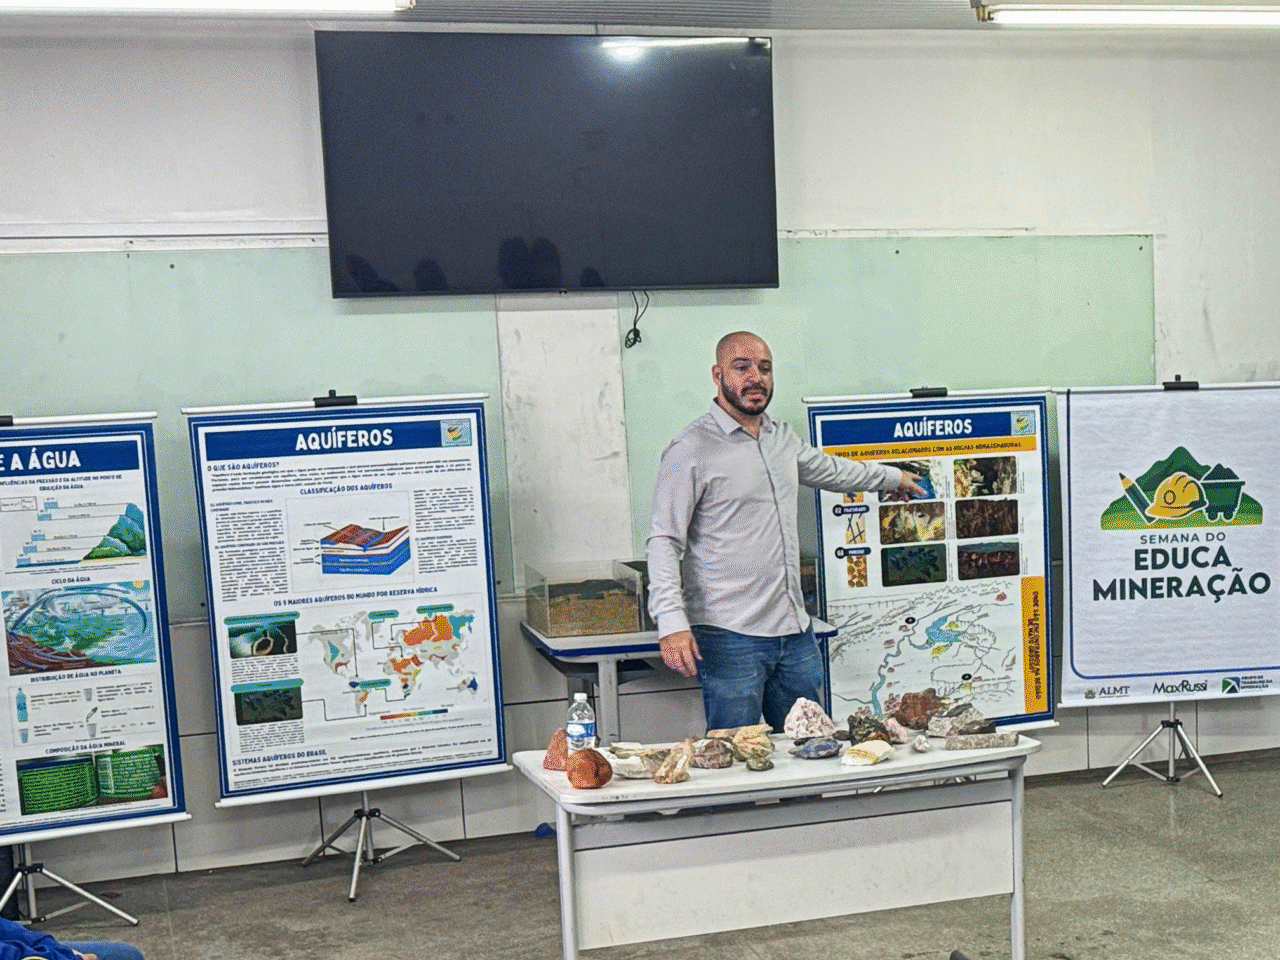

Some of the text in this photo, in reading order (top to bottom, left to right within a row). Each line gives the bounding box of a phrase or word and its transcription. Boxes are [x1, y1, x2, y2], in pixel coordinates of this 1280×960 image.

[893, 417, 972, 438] AQUÍFEROS
[295, 427, 393, 451] AQUÍFEROS
[10, 453, 24, 471] A
[28, 447, 82, 470] ÁGUA
[227, 462, 241, 470] SÃO
[300, 485, 345, 495] CLASSIFICAÇÃO
[360, 482, 393, 491] AQUÍFEROS
[1140, 532, 1226, 544] SEMANA DO
[1134, 545, 1232, 571] EDUCA
[1093, 567, 1271, 603] MINERAÇÃO
[1099, 685, 1130, 696] ALMT
[1153, 680, 1208, 694] MaxRussi
[232, 755, 261, 766] SISTEMAS
[262, 753, 295, 763] AQUÍFEROS
